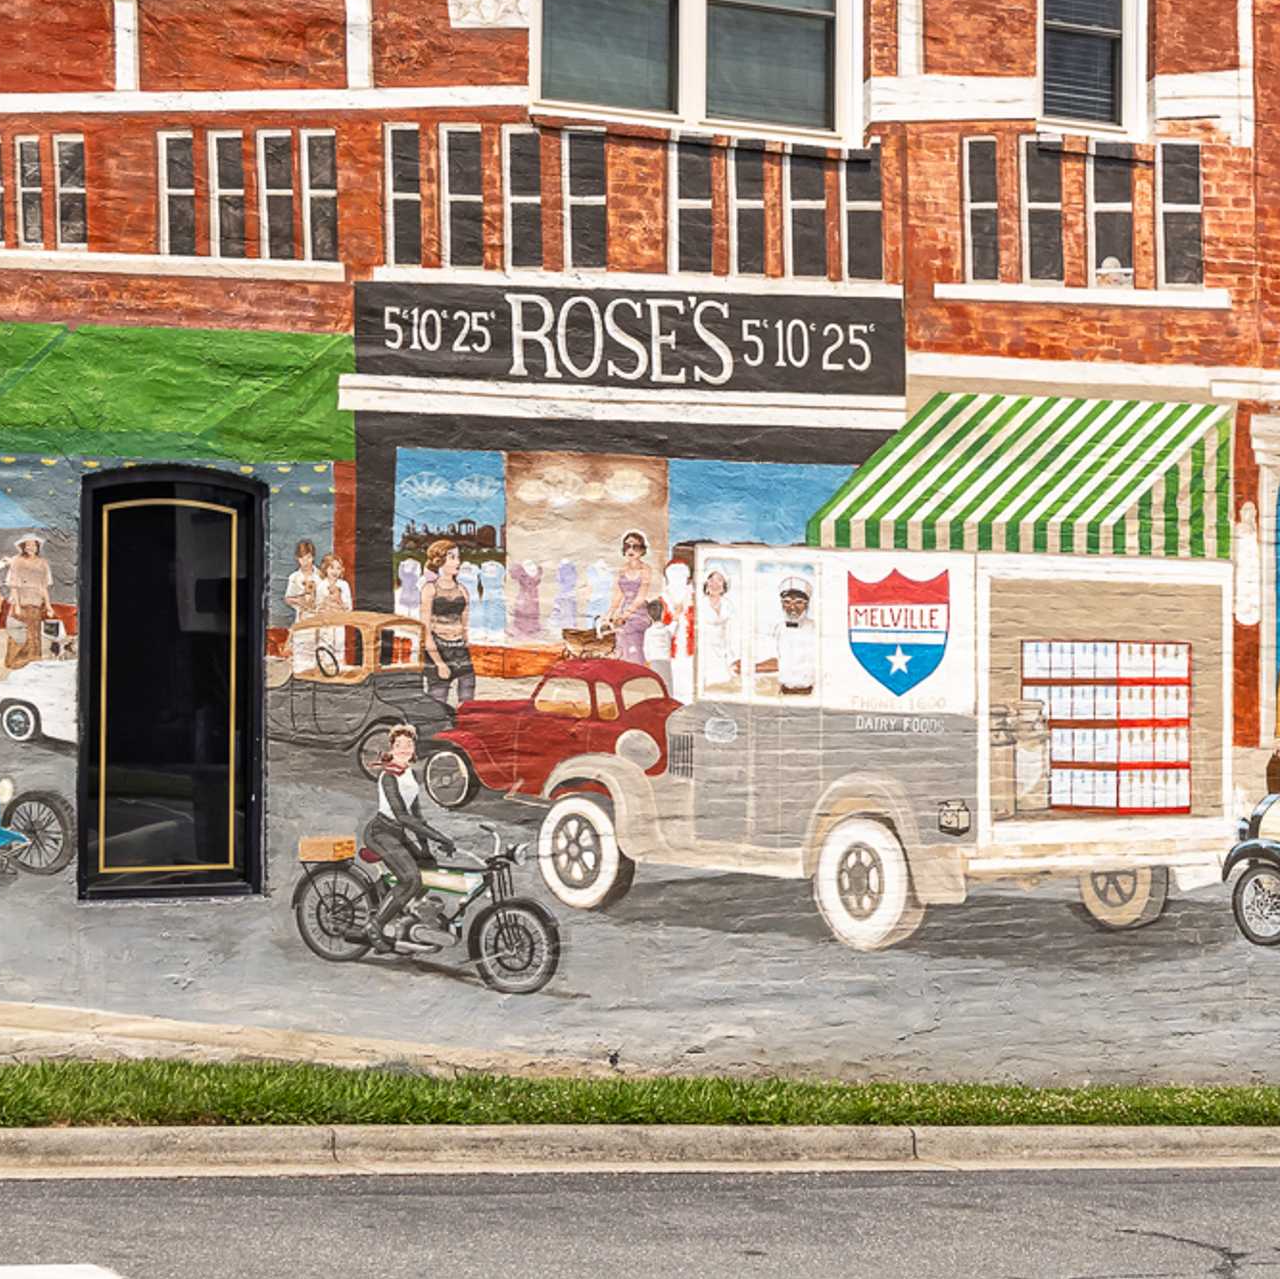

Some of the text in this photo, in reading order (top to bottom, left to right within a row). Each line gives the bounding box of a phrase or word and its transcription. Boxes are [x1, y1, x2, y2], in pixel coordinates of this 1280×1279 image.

[504, 293, 734, 386] ROSE'S
[853, 606, 940, 630] MELVILLE
[855, 715, 946, 736] DAIRY FOODS
